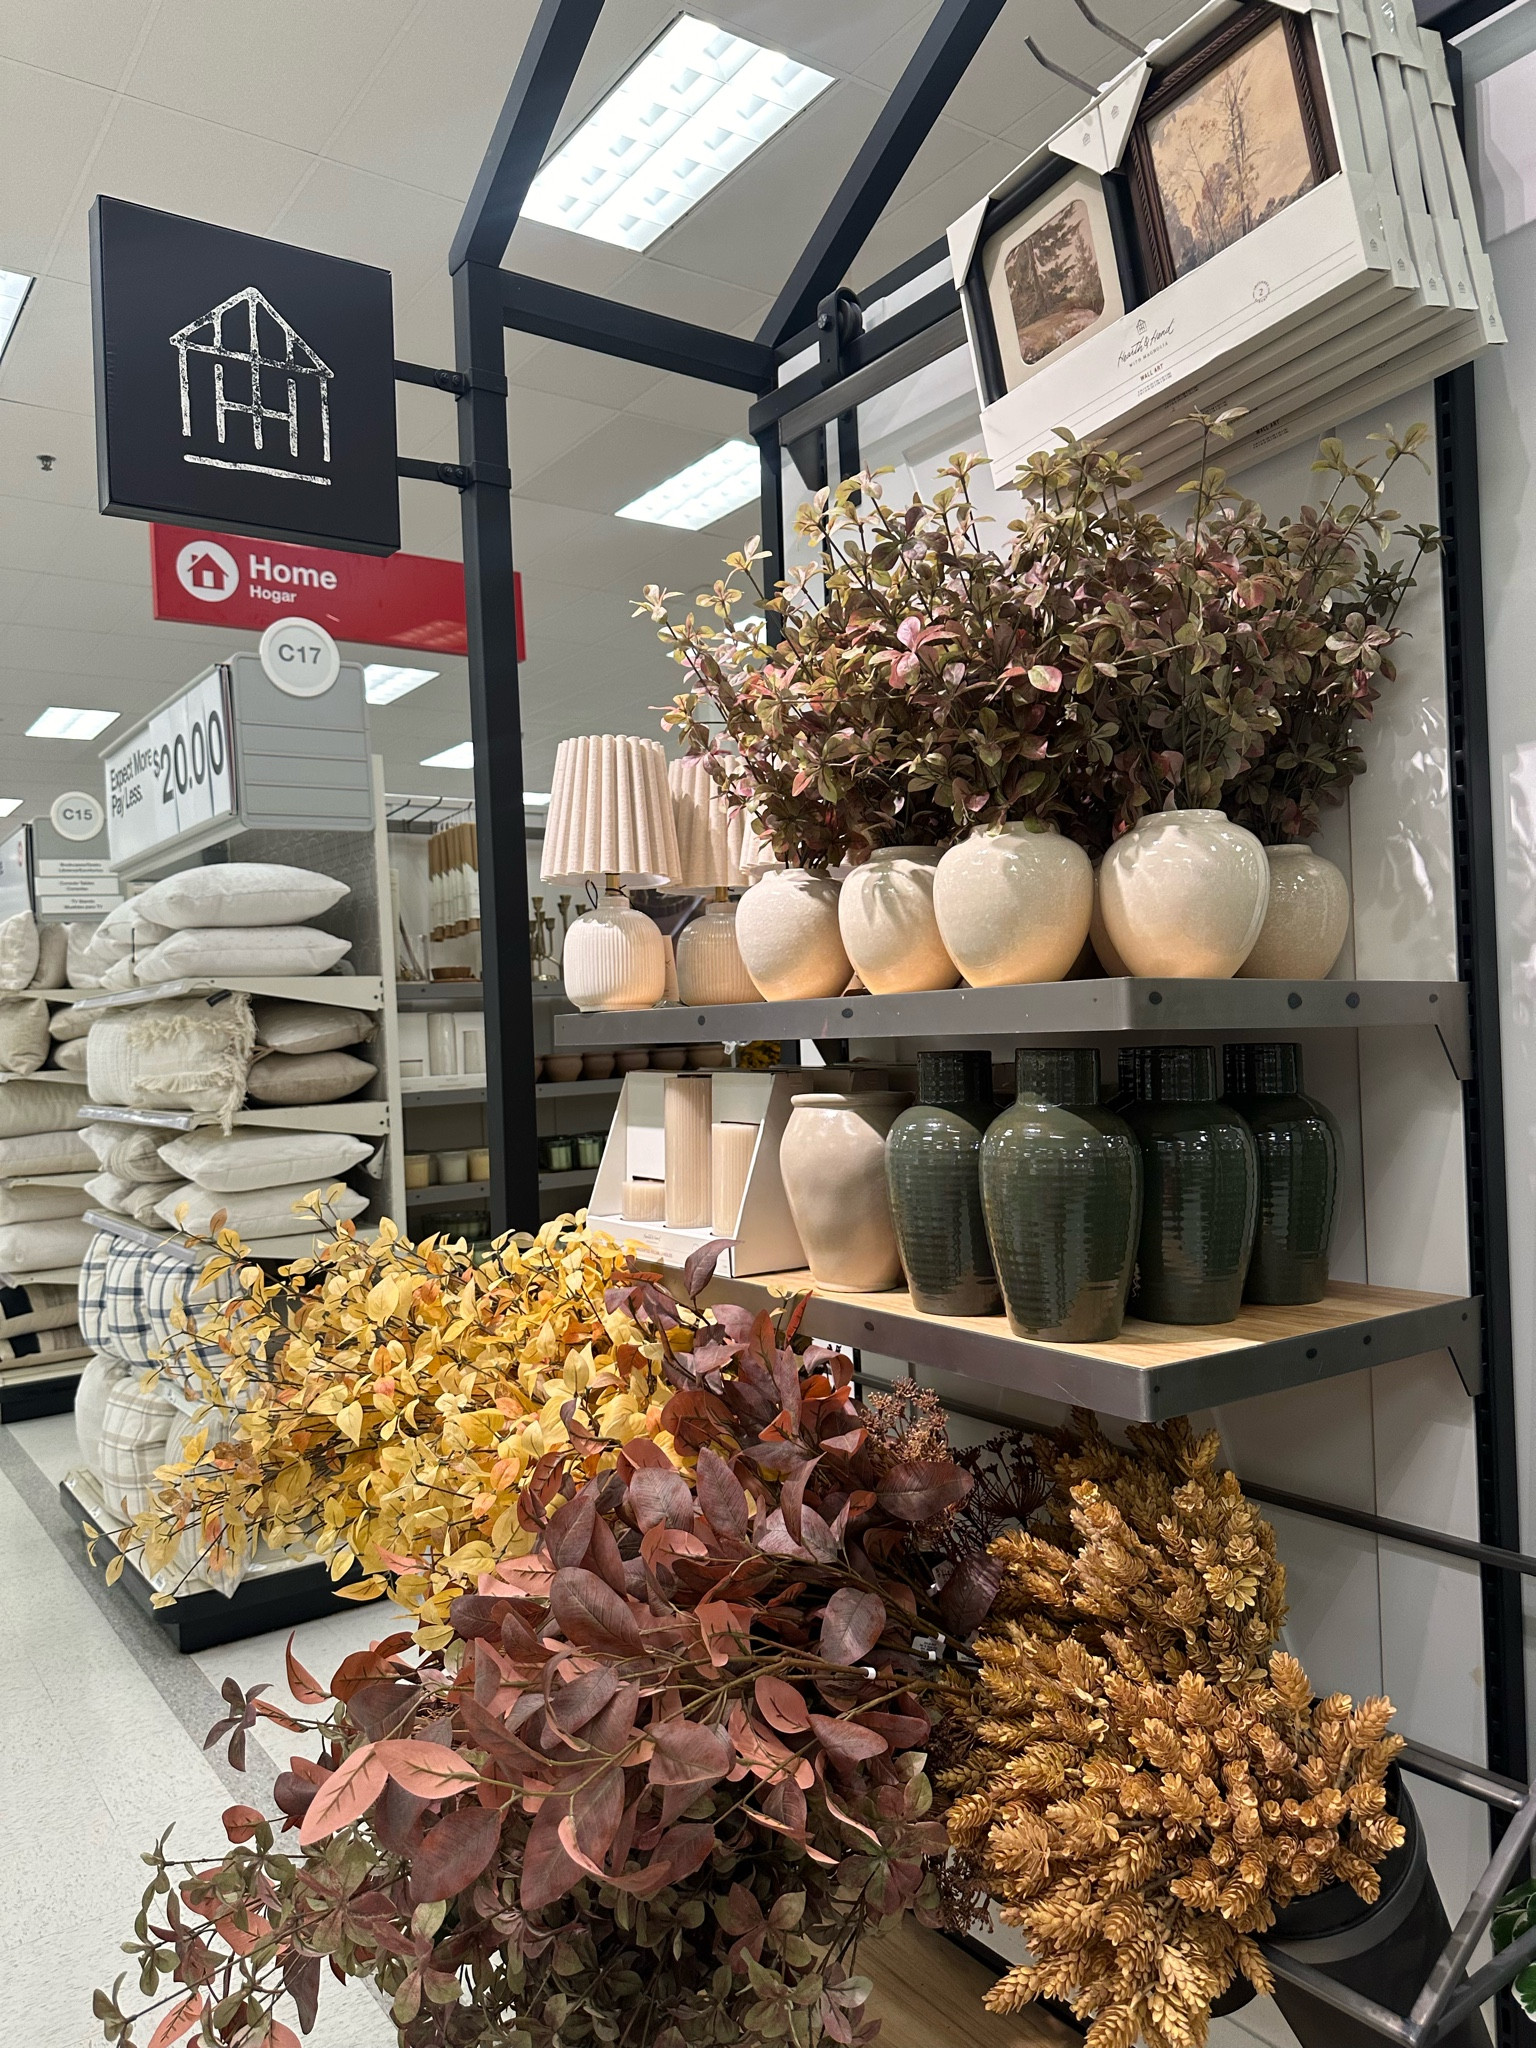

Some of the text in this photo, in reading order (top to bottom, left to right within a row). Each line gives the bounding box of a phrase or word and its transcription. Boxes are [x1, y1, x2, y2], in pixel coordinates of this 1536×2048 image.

[1140, 363, 1164, 381] WALL ART
[249, 553, 338, 590] Home
[249, 584, 297, 604] Hogar
[278, 643, 321, 665] C17
[153, 710, 224, 804] $20.00
[110, 757, 134, 792] Expect
[63, 807, 93, 820] C15
[111, 793, 125, 818] Pay
